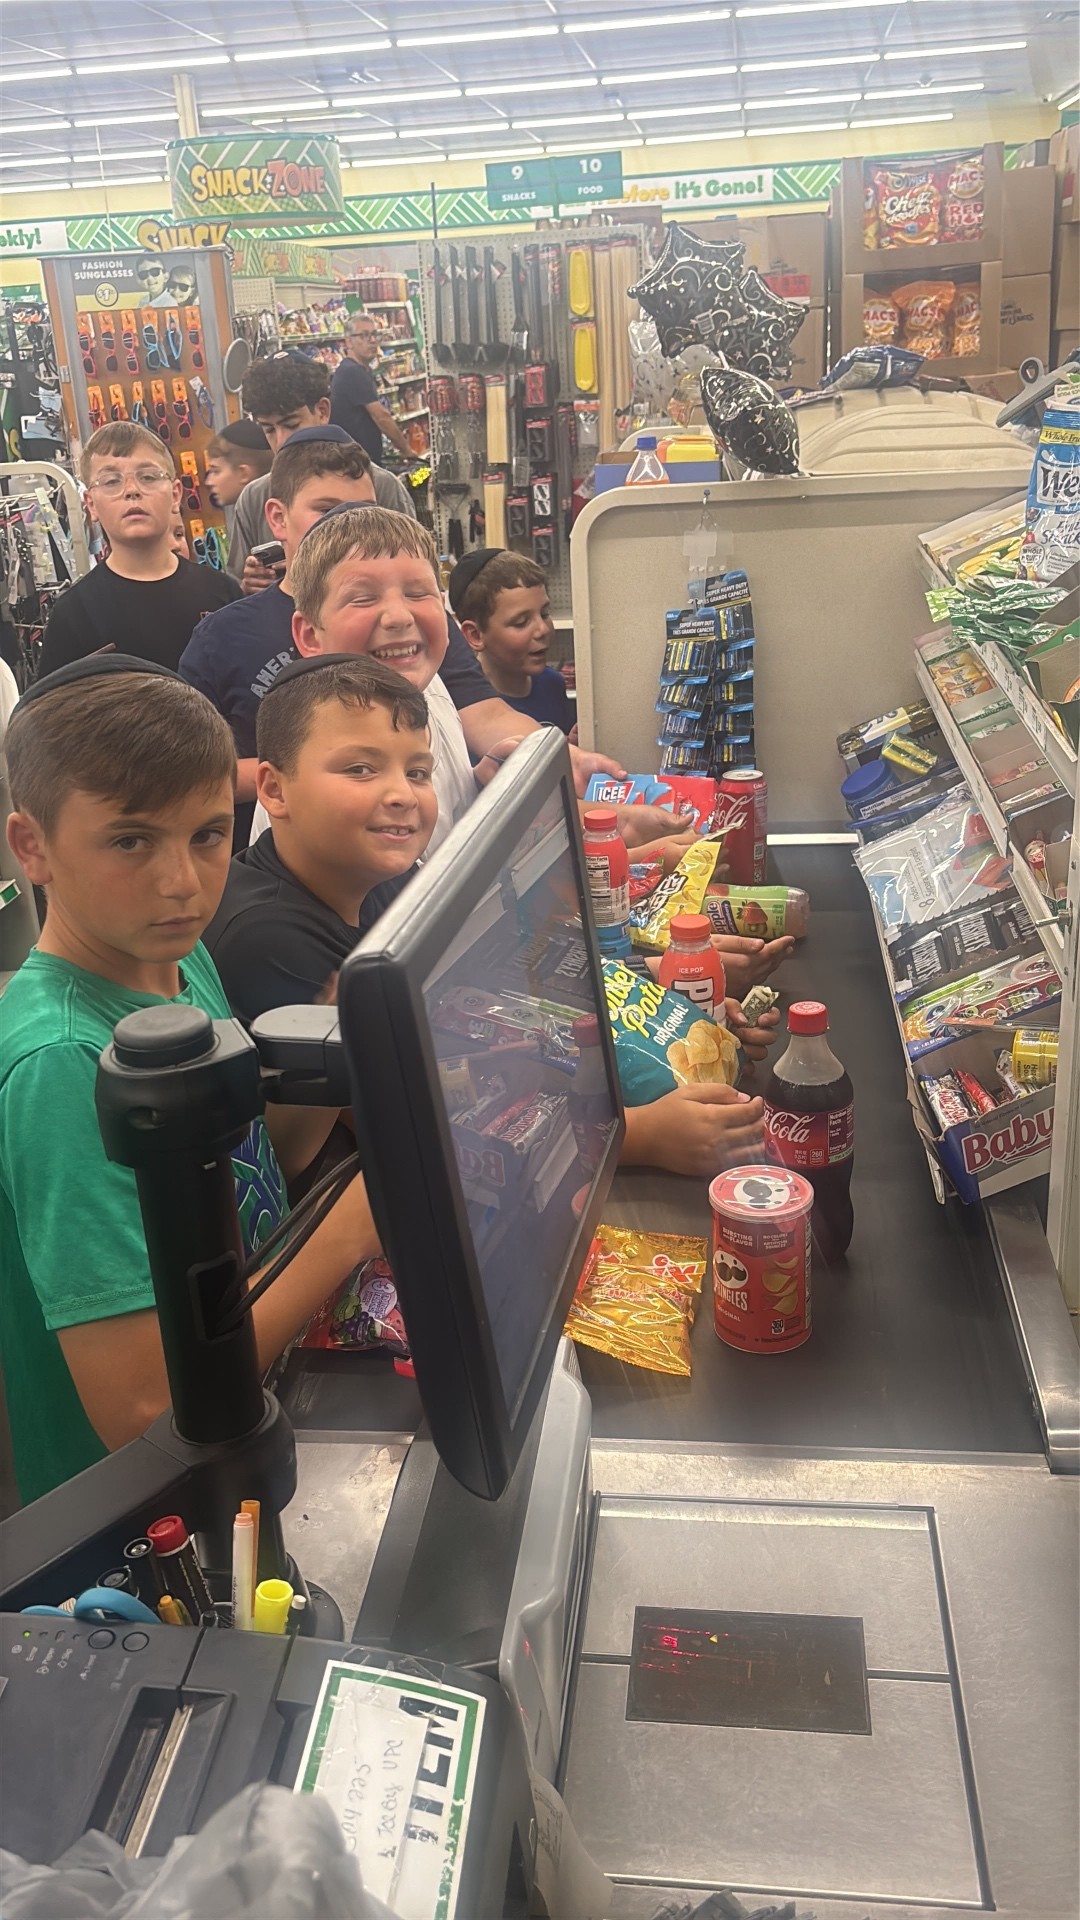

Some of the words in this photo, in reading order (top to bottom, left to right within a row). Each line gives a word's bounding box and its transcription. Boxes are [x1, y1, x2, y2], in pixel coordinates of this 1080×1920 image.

[511, 165, 523, 180] 9
[579, 159, 602, 173] 10
[190, 164, 267, 201] SNACK
[265, 159, 325, 198] ZONE
[502, 191, 536, 202] SNACKS
[577, 184, 604, 196] FOOD
[608, 184, 670, 204] efore
[674, 181, 702, 199] It's
[705, 175, 763, 197] Gone!
[950, 202, 984, 216] RED
[137, 219, 231, 251] SNACK
[82, 260, 123, 270] FASHION
[74, 269, 134, 280] SUNGLASSES
[736, 582, 747, 590] DUTY
[250, 647, 295, 699] AMER
[597, 786, 626, 800] ICEE
[862, 801, 885, 813] Nutrition
[918, 898, 936, 908] 8
[653, 1004, 689, 1046] ORIGINAL
[769, 1111, 816, 1143] Cola
[723, 1226, 753, 1241] BURSTING
[730, 1236, 753, 1247] FLAVOR
[717, 1305, 741, 1322] ORIGINAL
